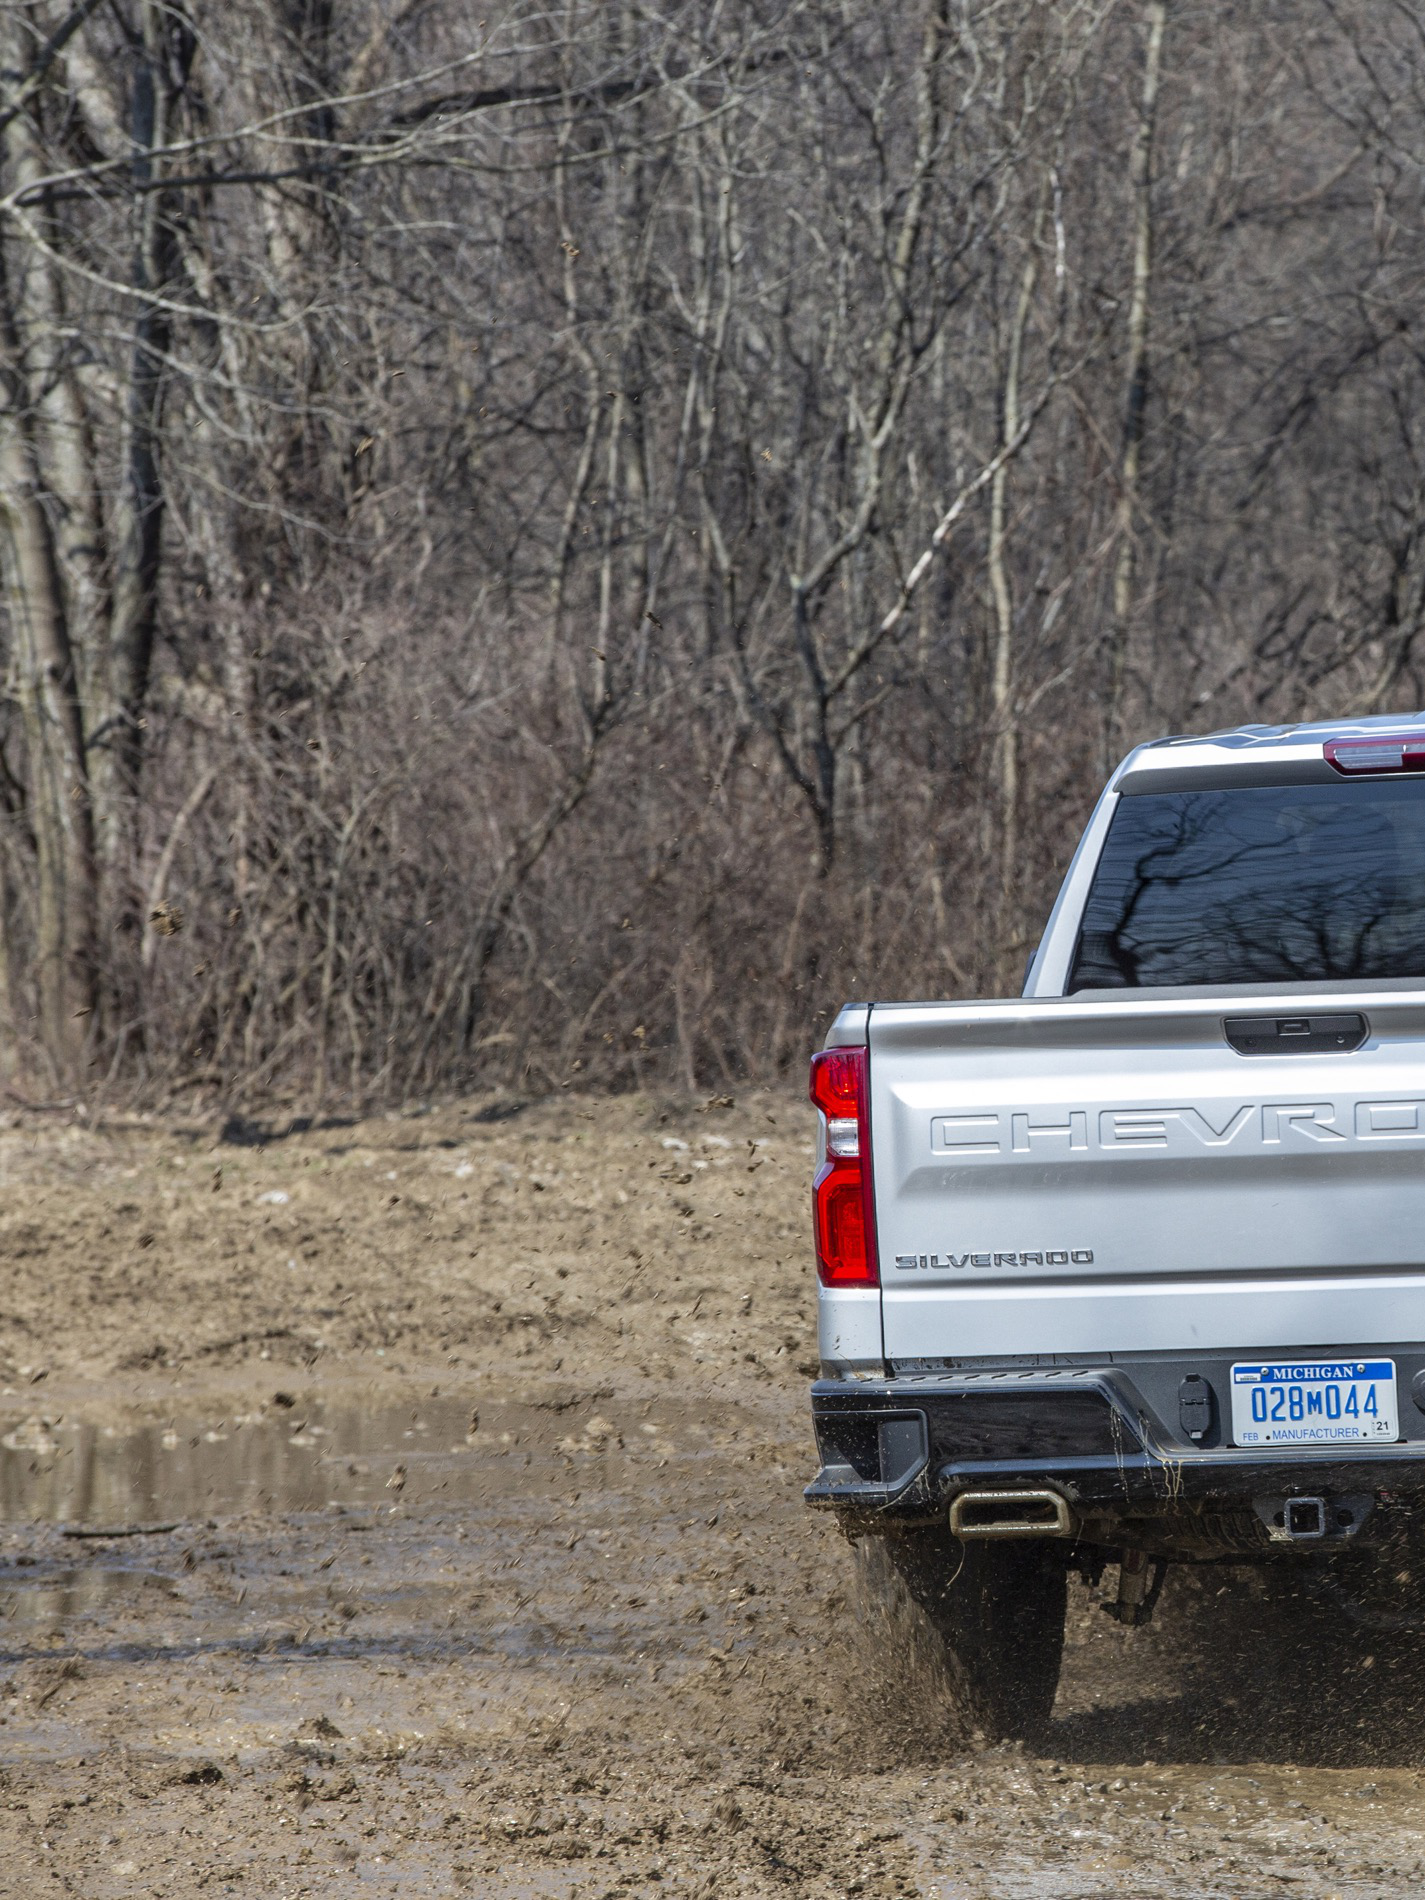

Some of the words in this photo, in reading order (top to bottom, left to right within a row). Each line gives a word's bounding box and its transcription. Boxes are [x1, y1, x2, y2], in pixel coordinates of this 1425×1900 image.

[895, 1249, 1094, 1269] SILVERADO
[1273, 1366, 1354, 1380] MICHIGAN
[1252, 1383, 1378, 1422] 028M044
[1376, 1421, 1389, 1431] 21
[1243, 1432, 1259, 1441] FEB
[1272, 1428, 1360, 1441] MANUFACTURER
